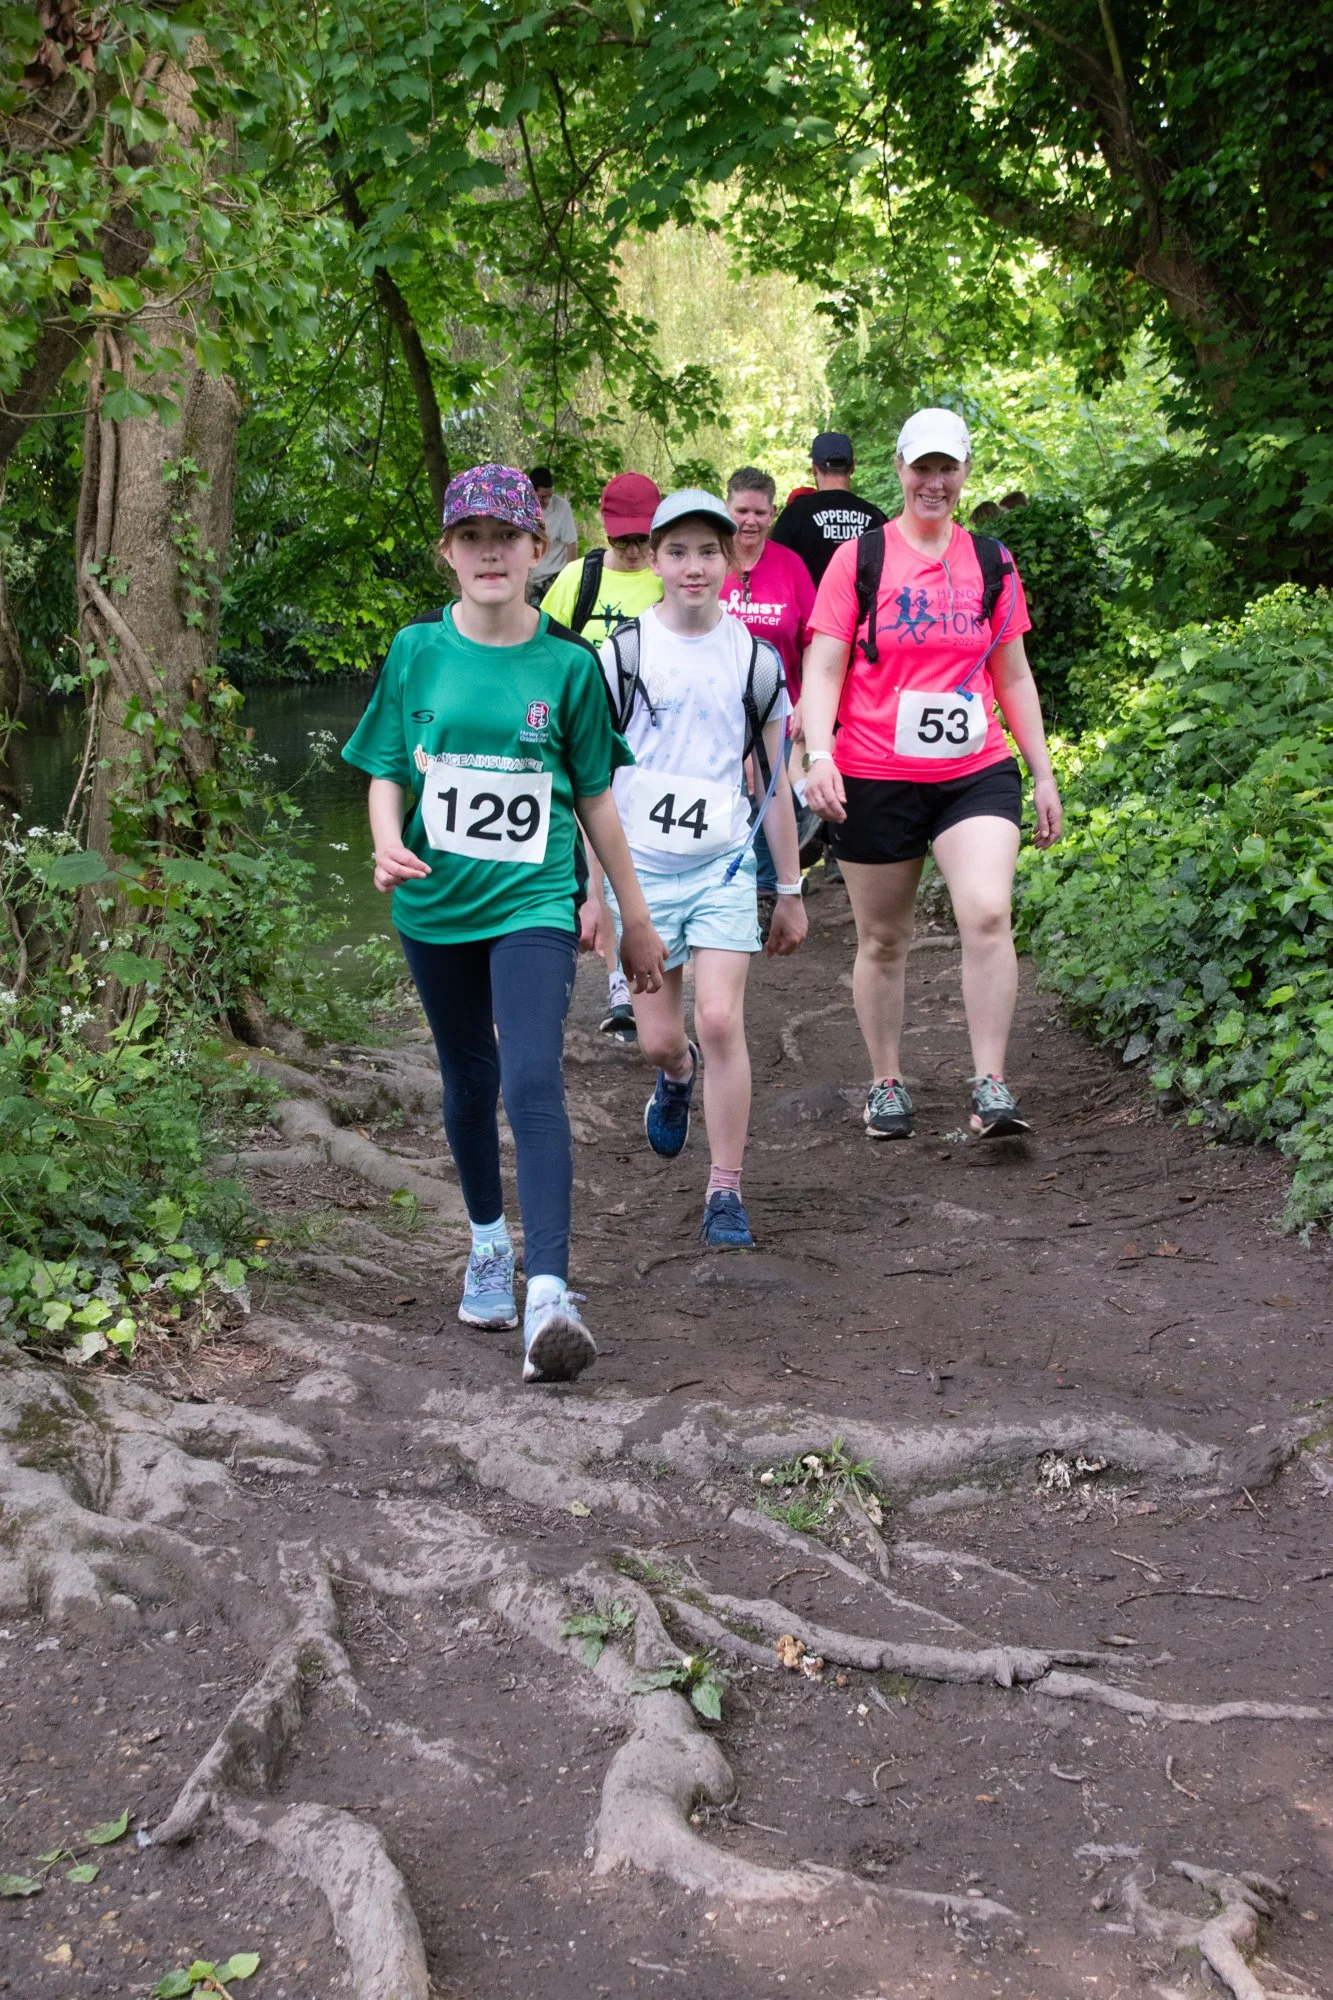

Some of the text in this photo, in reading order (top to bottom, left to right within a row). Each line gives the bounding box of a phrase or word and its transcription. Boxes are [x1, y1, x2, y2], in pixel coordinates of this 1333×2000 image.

[812, 509, 873, 527] UPPERCUT
[740, 614, 781, 626] cancer
[939, 612, 984, 635] 10K
[953, 637, 976, 646] 2022
[917, 707, 969, 745] 53
[437, 786, 541, 843] 129
[649, 793, 709, 840] 44
